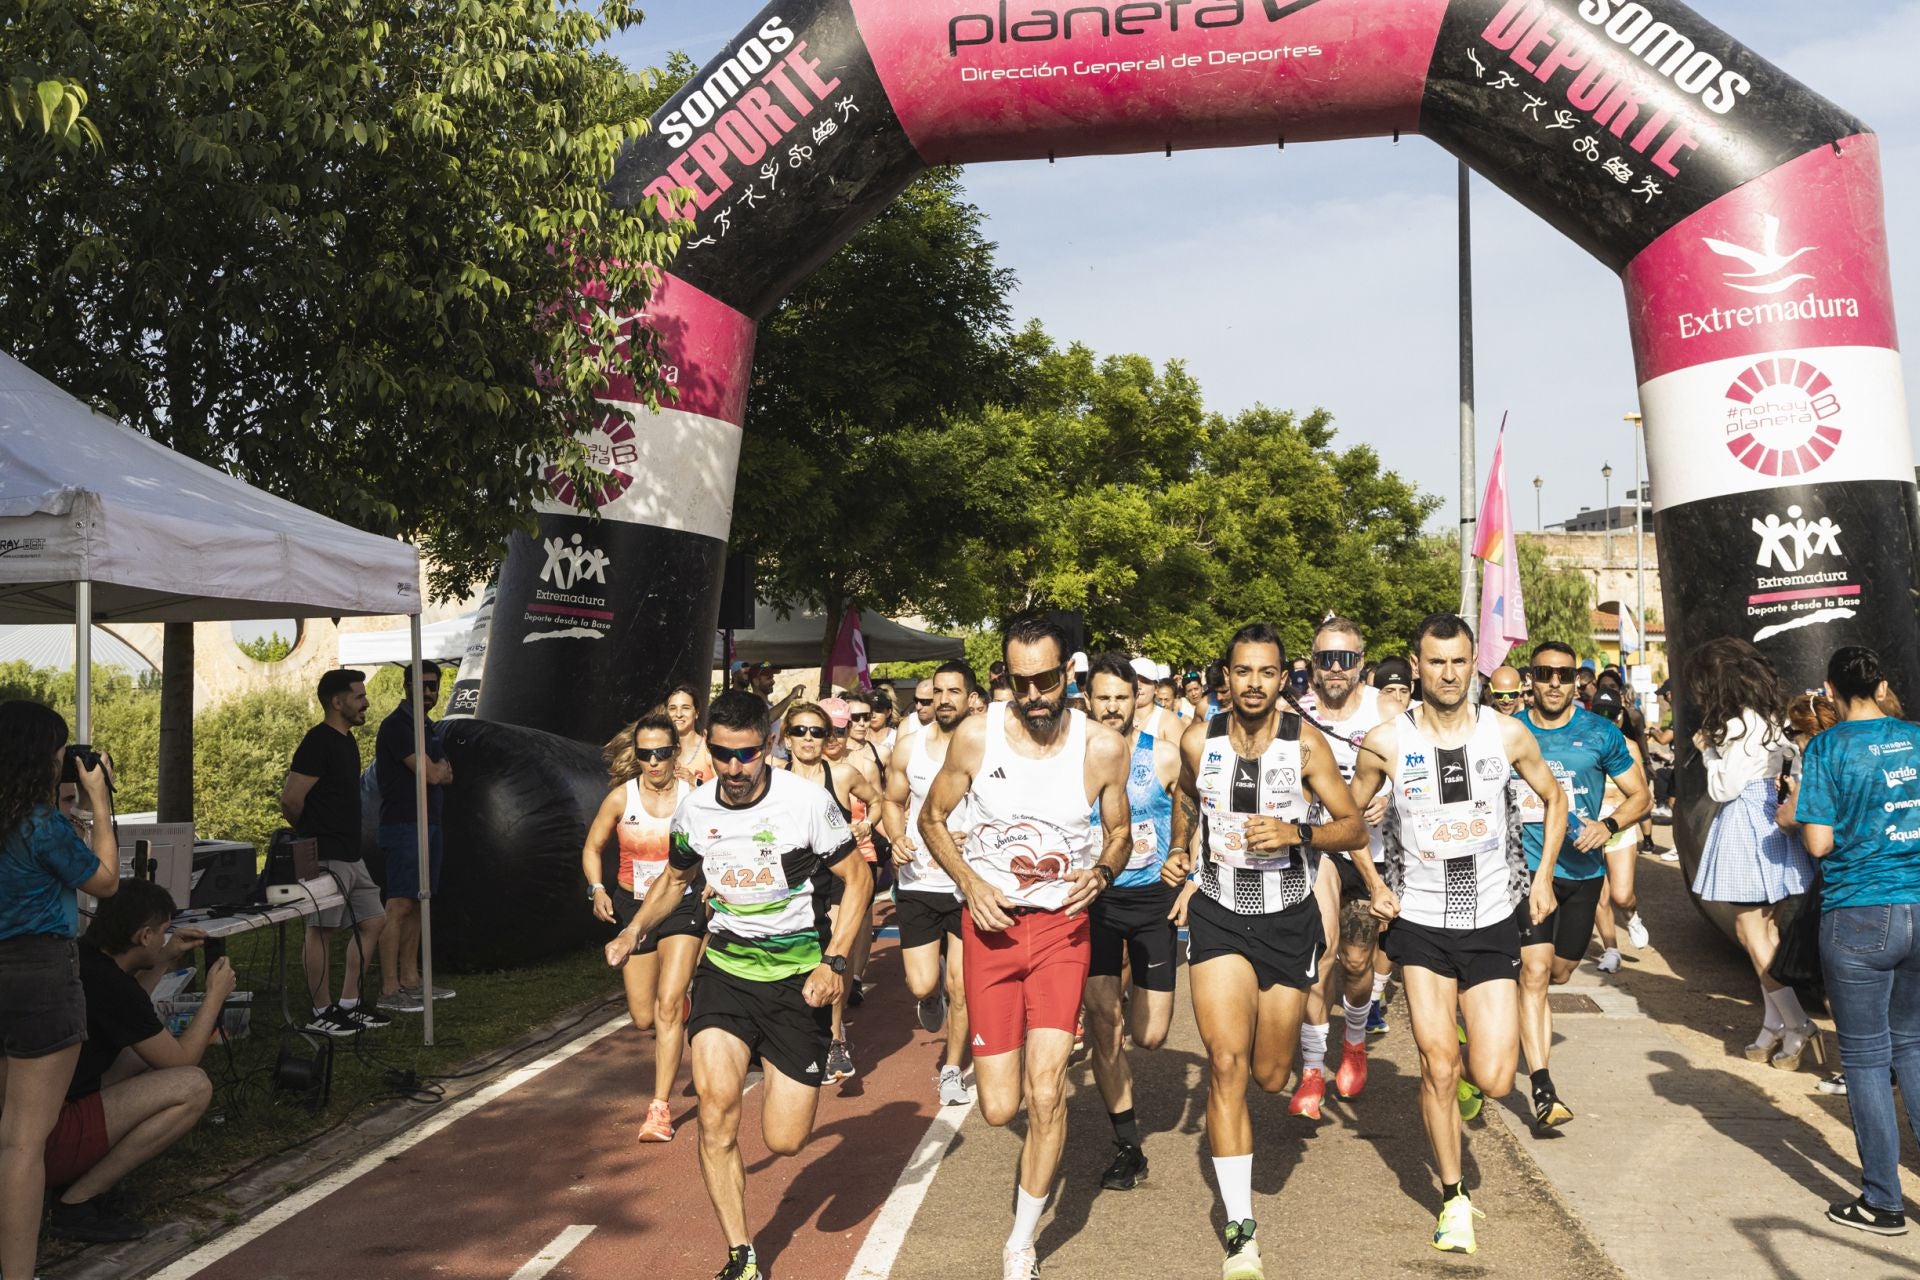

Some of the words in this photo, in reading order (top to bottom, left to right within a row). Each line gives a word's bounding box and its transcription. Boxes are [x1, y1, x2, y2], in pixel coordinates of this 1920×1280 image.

[961, 62, 1067, 82] Dirección
[1074, 54, 1165, 75] General
[1172, 52, 1203, 68] de
[1208, 43, 1323, 66] Deportes
[1678, 292, 1859, 340] Extremadura
[1727, 400, 1807, 420] #nohay
[1726, 413, 1812, 436] planeta
[1757, 571, 1848, 589] Extremadura
[536, 589, 606, 607] Extremadura
[1747, 604, 1788, 617] Deporte
[1791, 600, 1822, 612] desde
[1825, 598, 1835, 608] la
[1838, 597, 1861, 608] Base
[524, 612, 552, 623] Deporte
[554, 616, 578, 626] desde
[581, 618, 589, 627] la
[591, 620, 611, 630] Base
[1432, 818, 1488, 842] 436
[720, 867, 775, 888] 424
